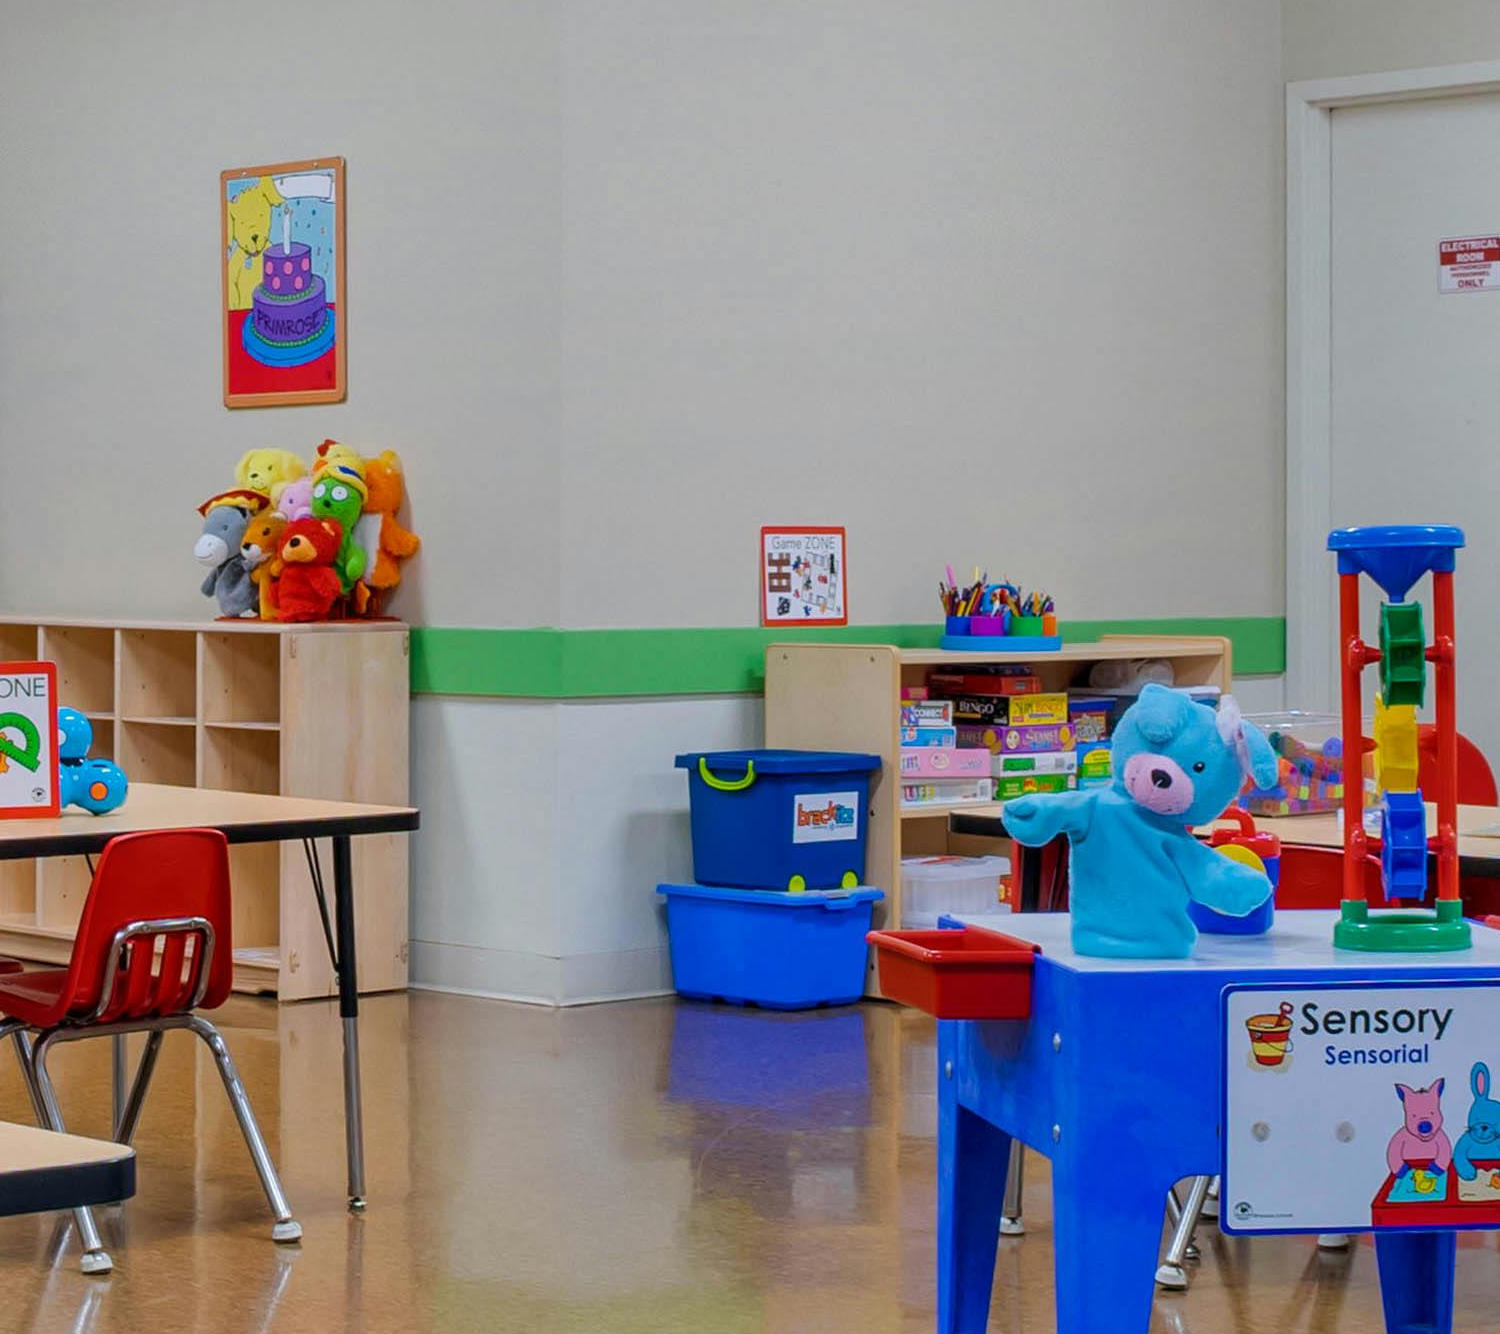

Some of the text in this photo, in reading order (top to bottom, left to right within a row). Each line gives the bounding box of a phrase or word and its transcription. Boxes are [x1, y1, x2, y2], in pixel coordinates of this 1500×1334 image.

[1441, 238, 1499, 252] ELECTRICAL
[1457, 278, 1485, 288] ONLY
[256, 307, 323, 336] PRIMROSE
[772, 536, 836, 549] Game ZONE
[959, 700, 995, 715] BINGO
[1300, 1002, 1453, 1040] Sensory
[1325, 1043, 1429, 1066] Sensorial
